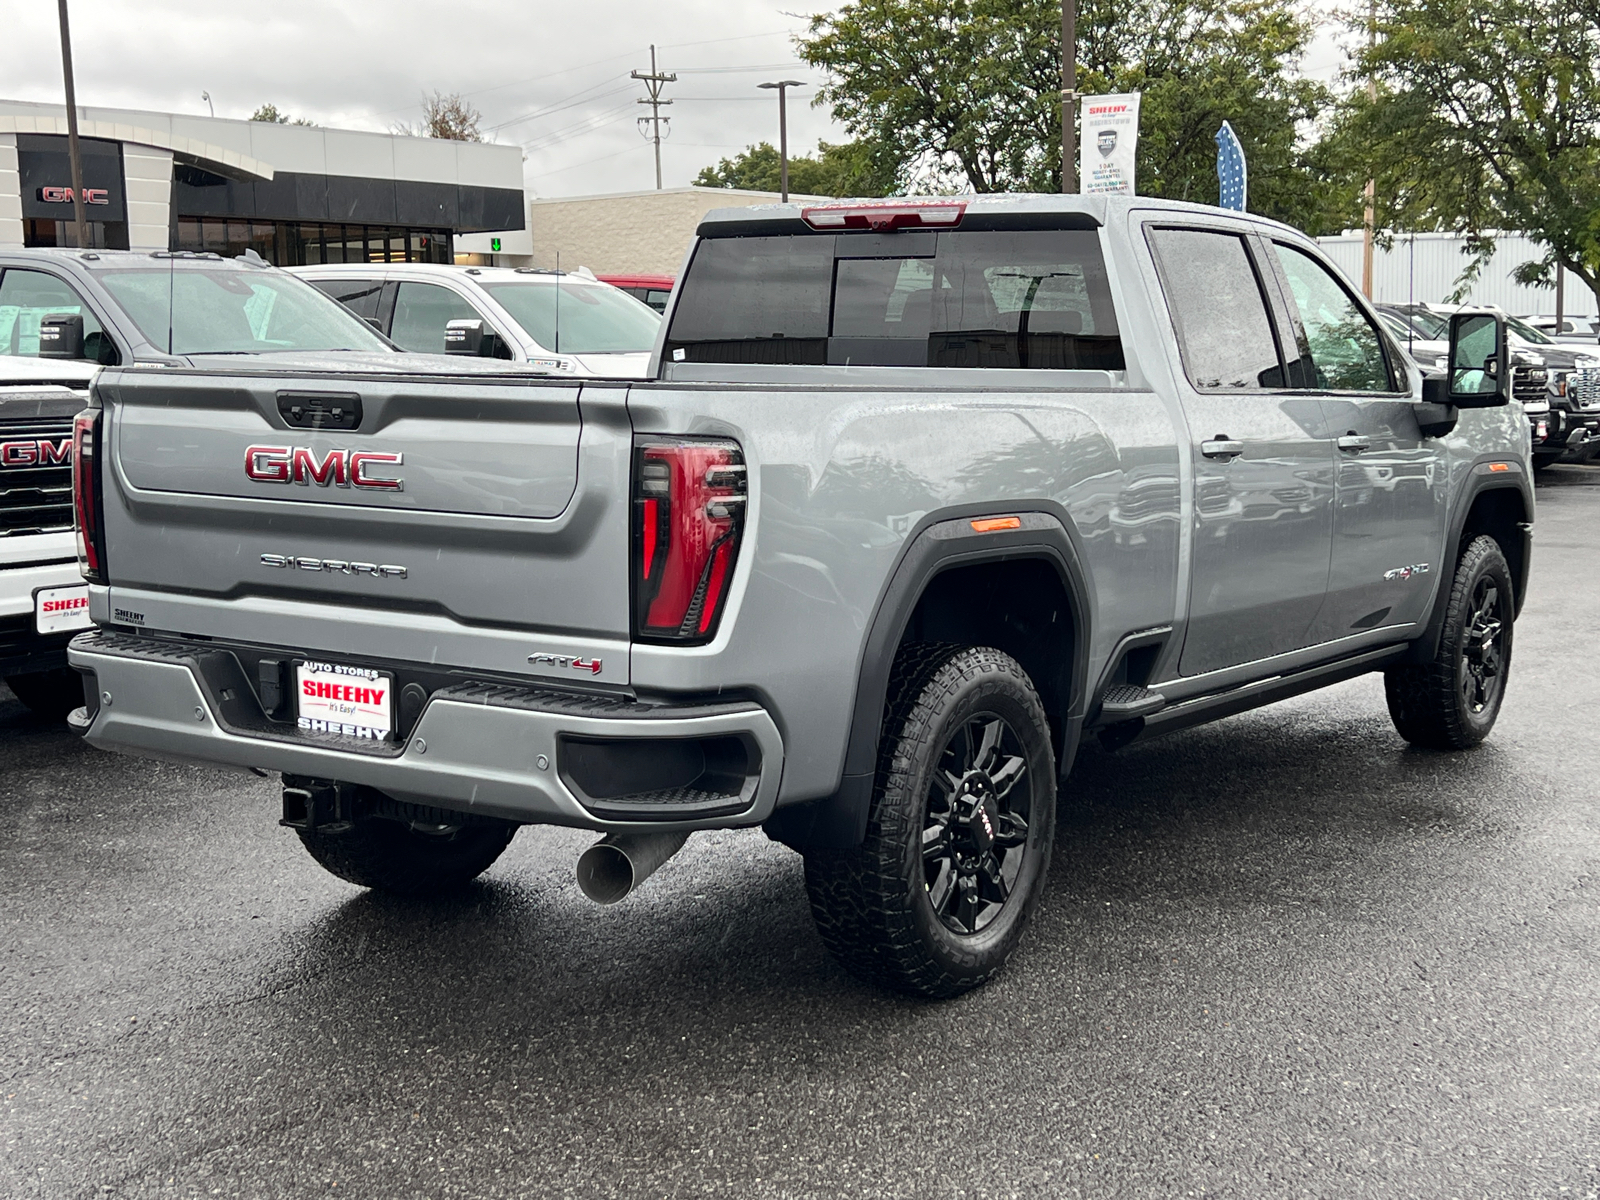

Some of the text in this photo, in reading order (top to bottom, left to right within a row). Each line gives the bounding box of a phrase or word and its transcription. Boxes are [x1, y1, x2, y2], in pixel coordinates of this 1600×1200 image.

[1089, 105, 1127, 114] SHEEHY
[43, 186, 109, 205] GMC
[0, 438, 73, 466] GM
[245, 444, 404, 492] GMC
[260, 553, 408, 579] SIERRA
[43, 597, 89, 612] SHEEH
[115, 608, 144, 620] SHEEHY
[303, 661, 379, 679] AUTO STORES
[527, 651, 602, 676] AT4
[303, 680, 385, 706] SHEEHY
[329, 702, 356, 716] It's Easy!
[297, 717, 389, 741] SHEEHY
